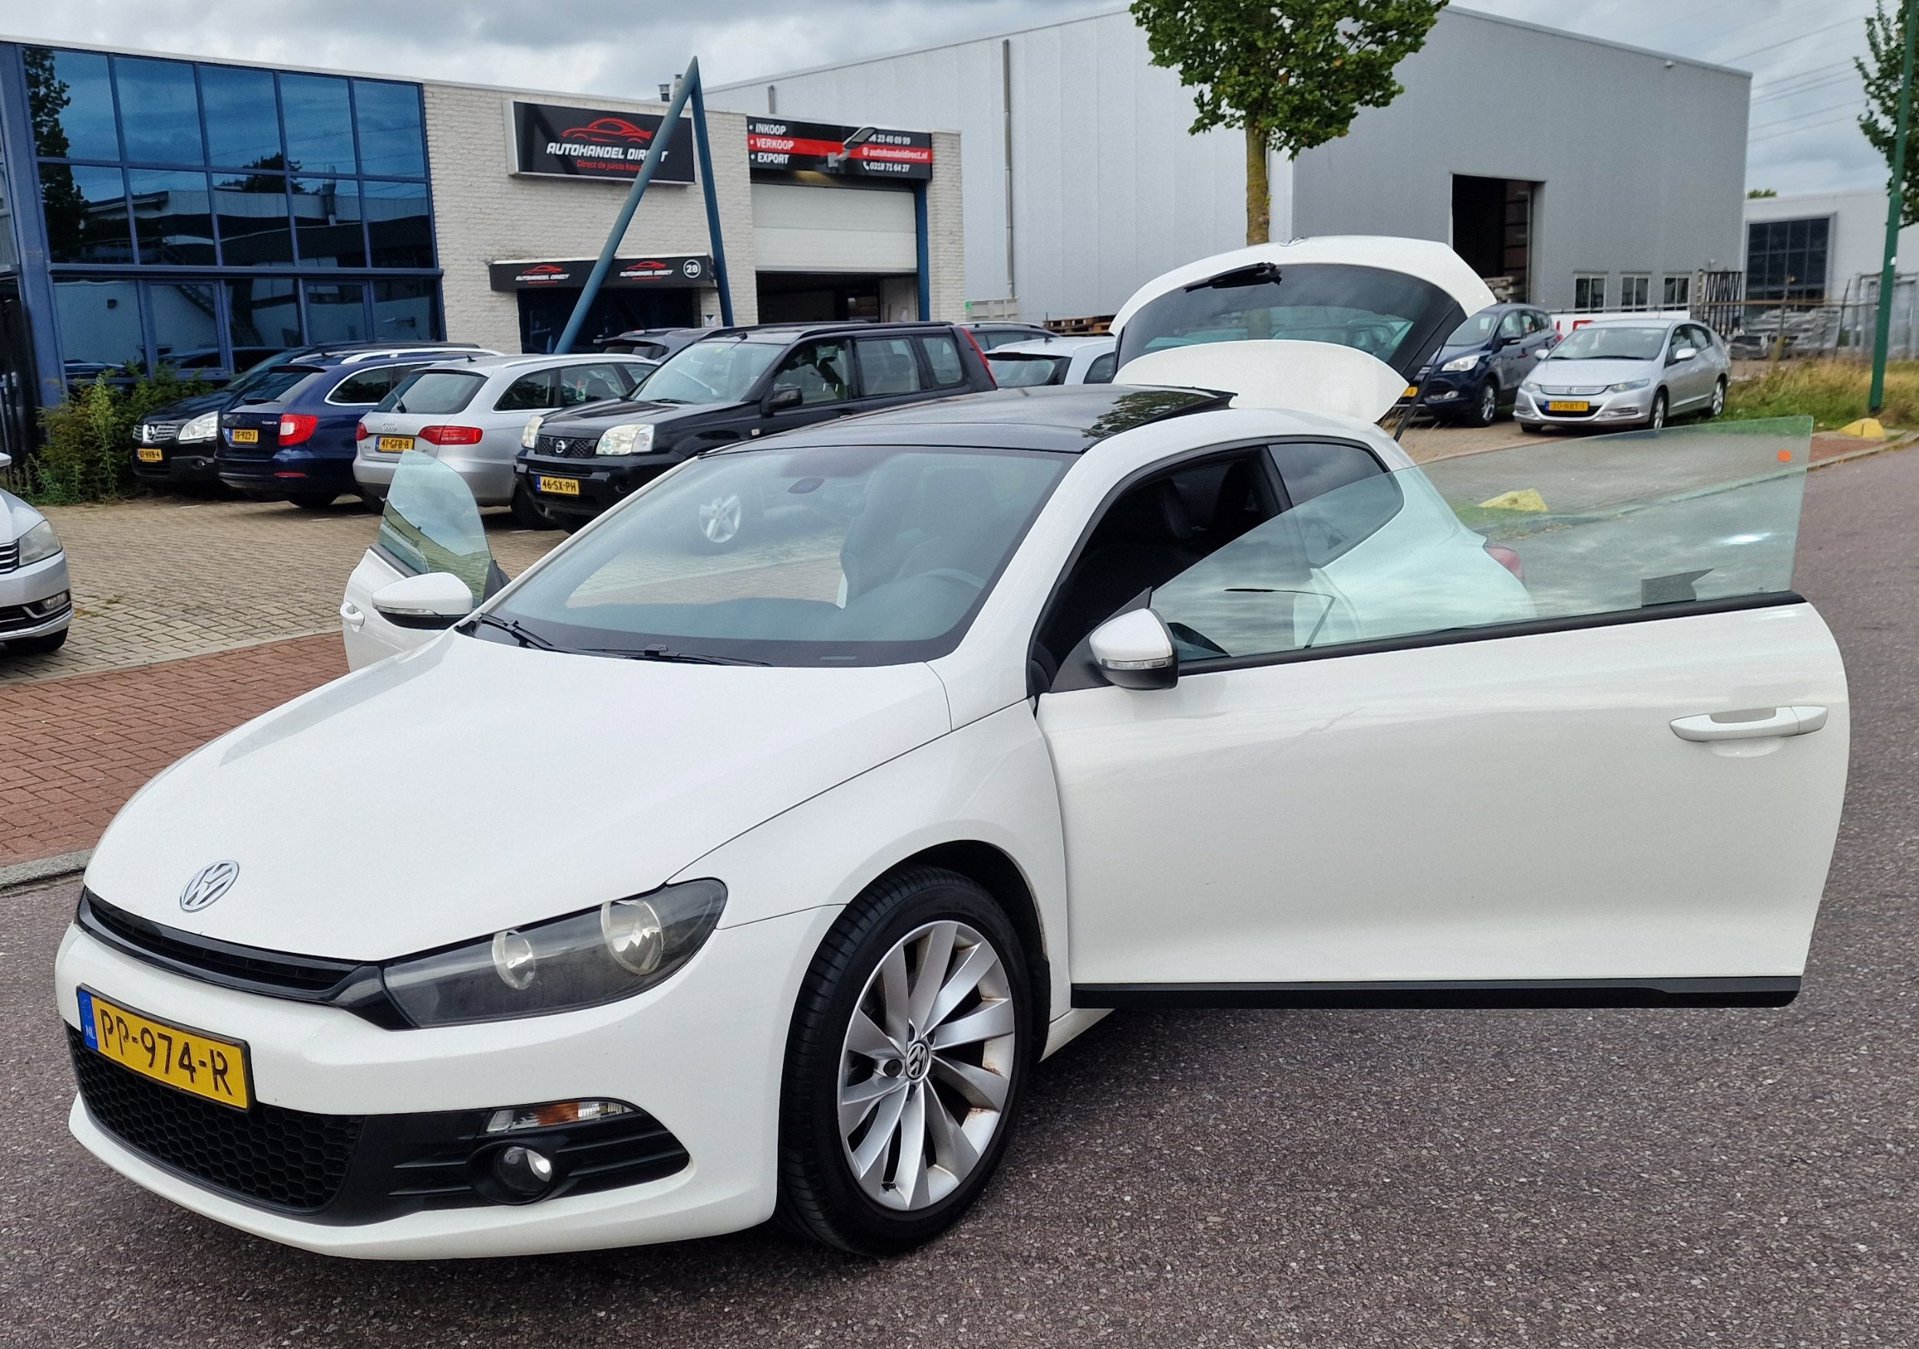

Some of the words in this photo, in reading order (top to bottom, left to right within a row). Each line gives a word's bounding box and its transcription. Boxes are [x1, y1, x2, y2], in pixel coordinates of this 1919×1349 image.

[755, 123, 786, 135] INKOOP
[756, 138, 794, 150] VERKOOP
[546, 142, 624, 160] AUTOHANDEL
[627, 148, 668, 162] DIRT
[757, 152, 790, 164] EXPORT
[686, 264, 699, 273] 28
[542, 479, 577, 492] 46-SX-PH
[85, 1025, 96, 1040] NL
[100, 1008, 233, 1096] PP-974-R
